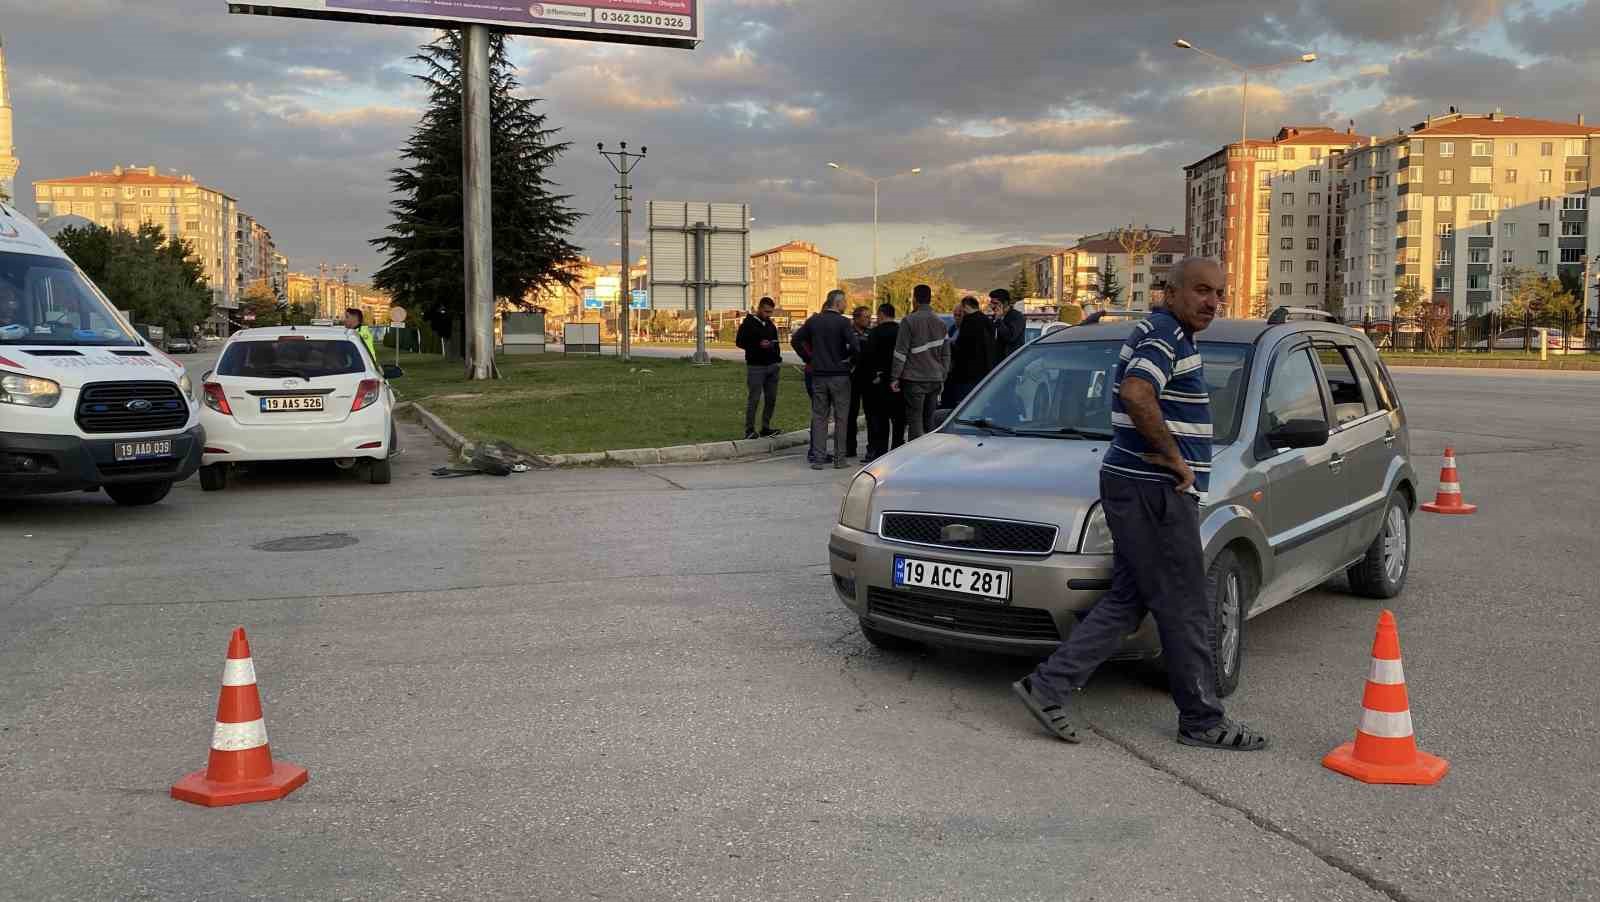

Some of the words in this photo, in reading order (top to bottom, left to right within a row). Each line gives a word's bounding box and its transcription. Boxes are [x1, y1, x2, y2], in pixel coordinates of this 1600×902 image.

[601, 12, 608, 21] 0
[610, 13, 630, 23] 362
[633, 14, 652, 25] 330
[655, 17, 662, 26] 0
[664, 17, 684, 28] 326
[267, 399, 279, 409] 19
[282, 399, 301, 409] AAS
[303, 398, 322, 408] 526
[121, 444, 132, 456] 19
[906, 561, 925, 583] 19
[930, 565, 964, 589] ACC
[969, 570, 1004, 595] 281
